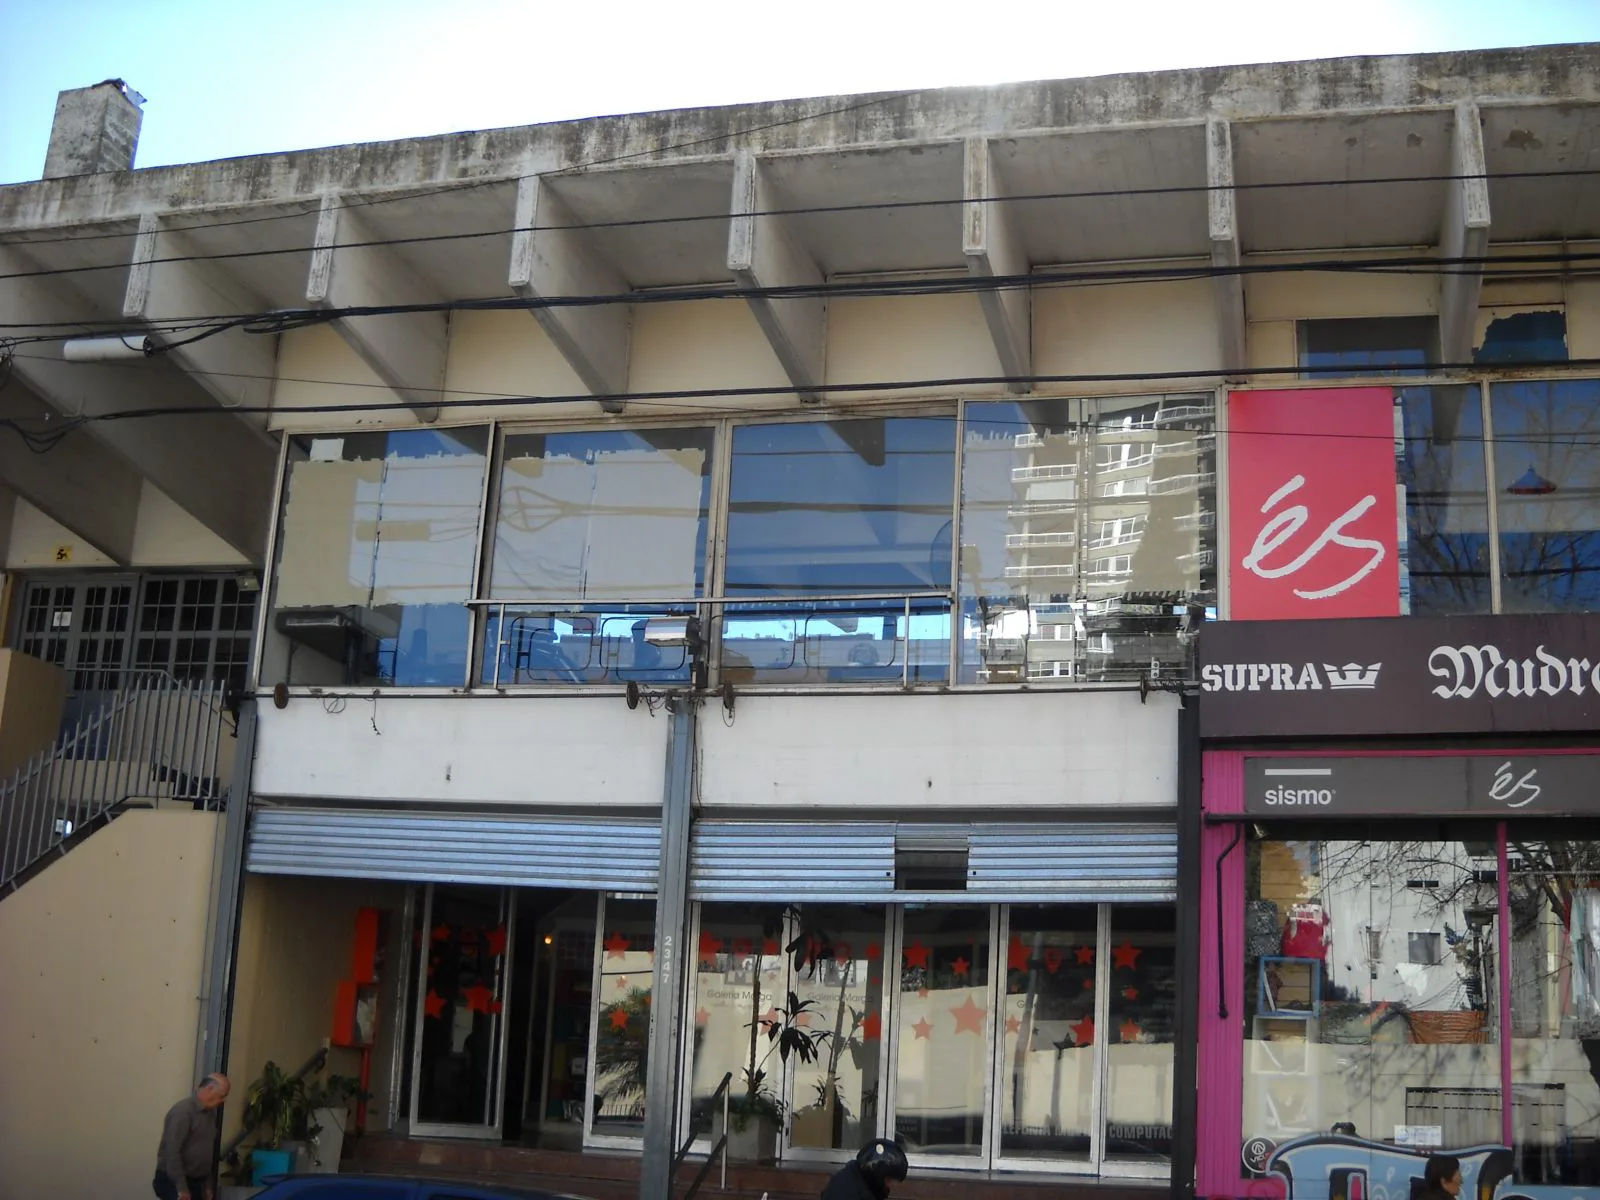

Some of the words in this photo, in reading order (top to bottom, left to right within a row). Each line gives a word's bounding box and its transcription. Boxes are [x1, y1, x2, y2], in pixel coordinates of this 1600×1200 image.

[1201, 662, 1323, 692] SUPRA
[1264, 784, 1332, 805] sismo
[663, 935, 672, 984] 2347
[741, 991, 772, 1003] Mga
